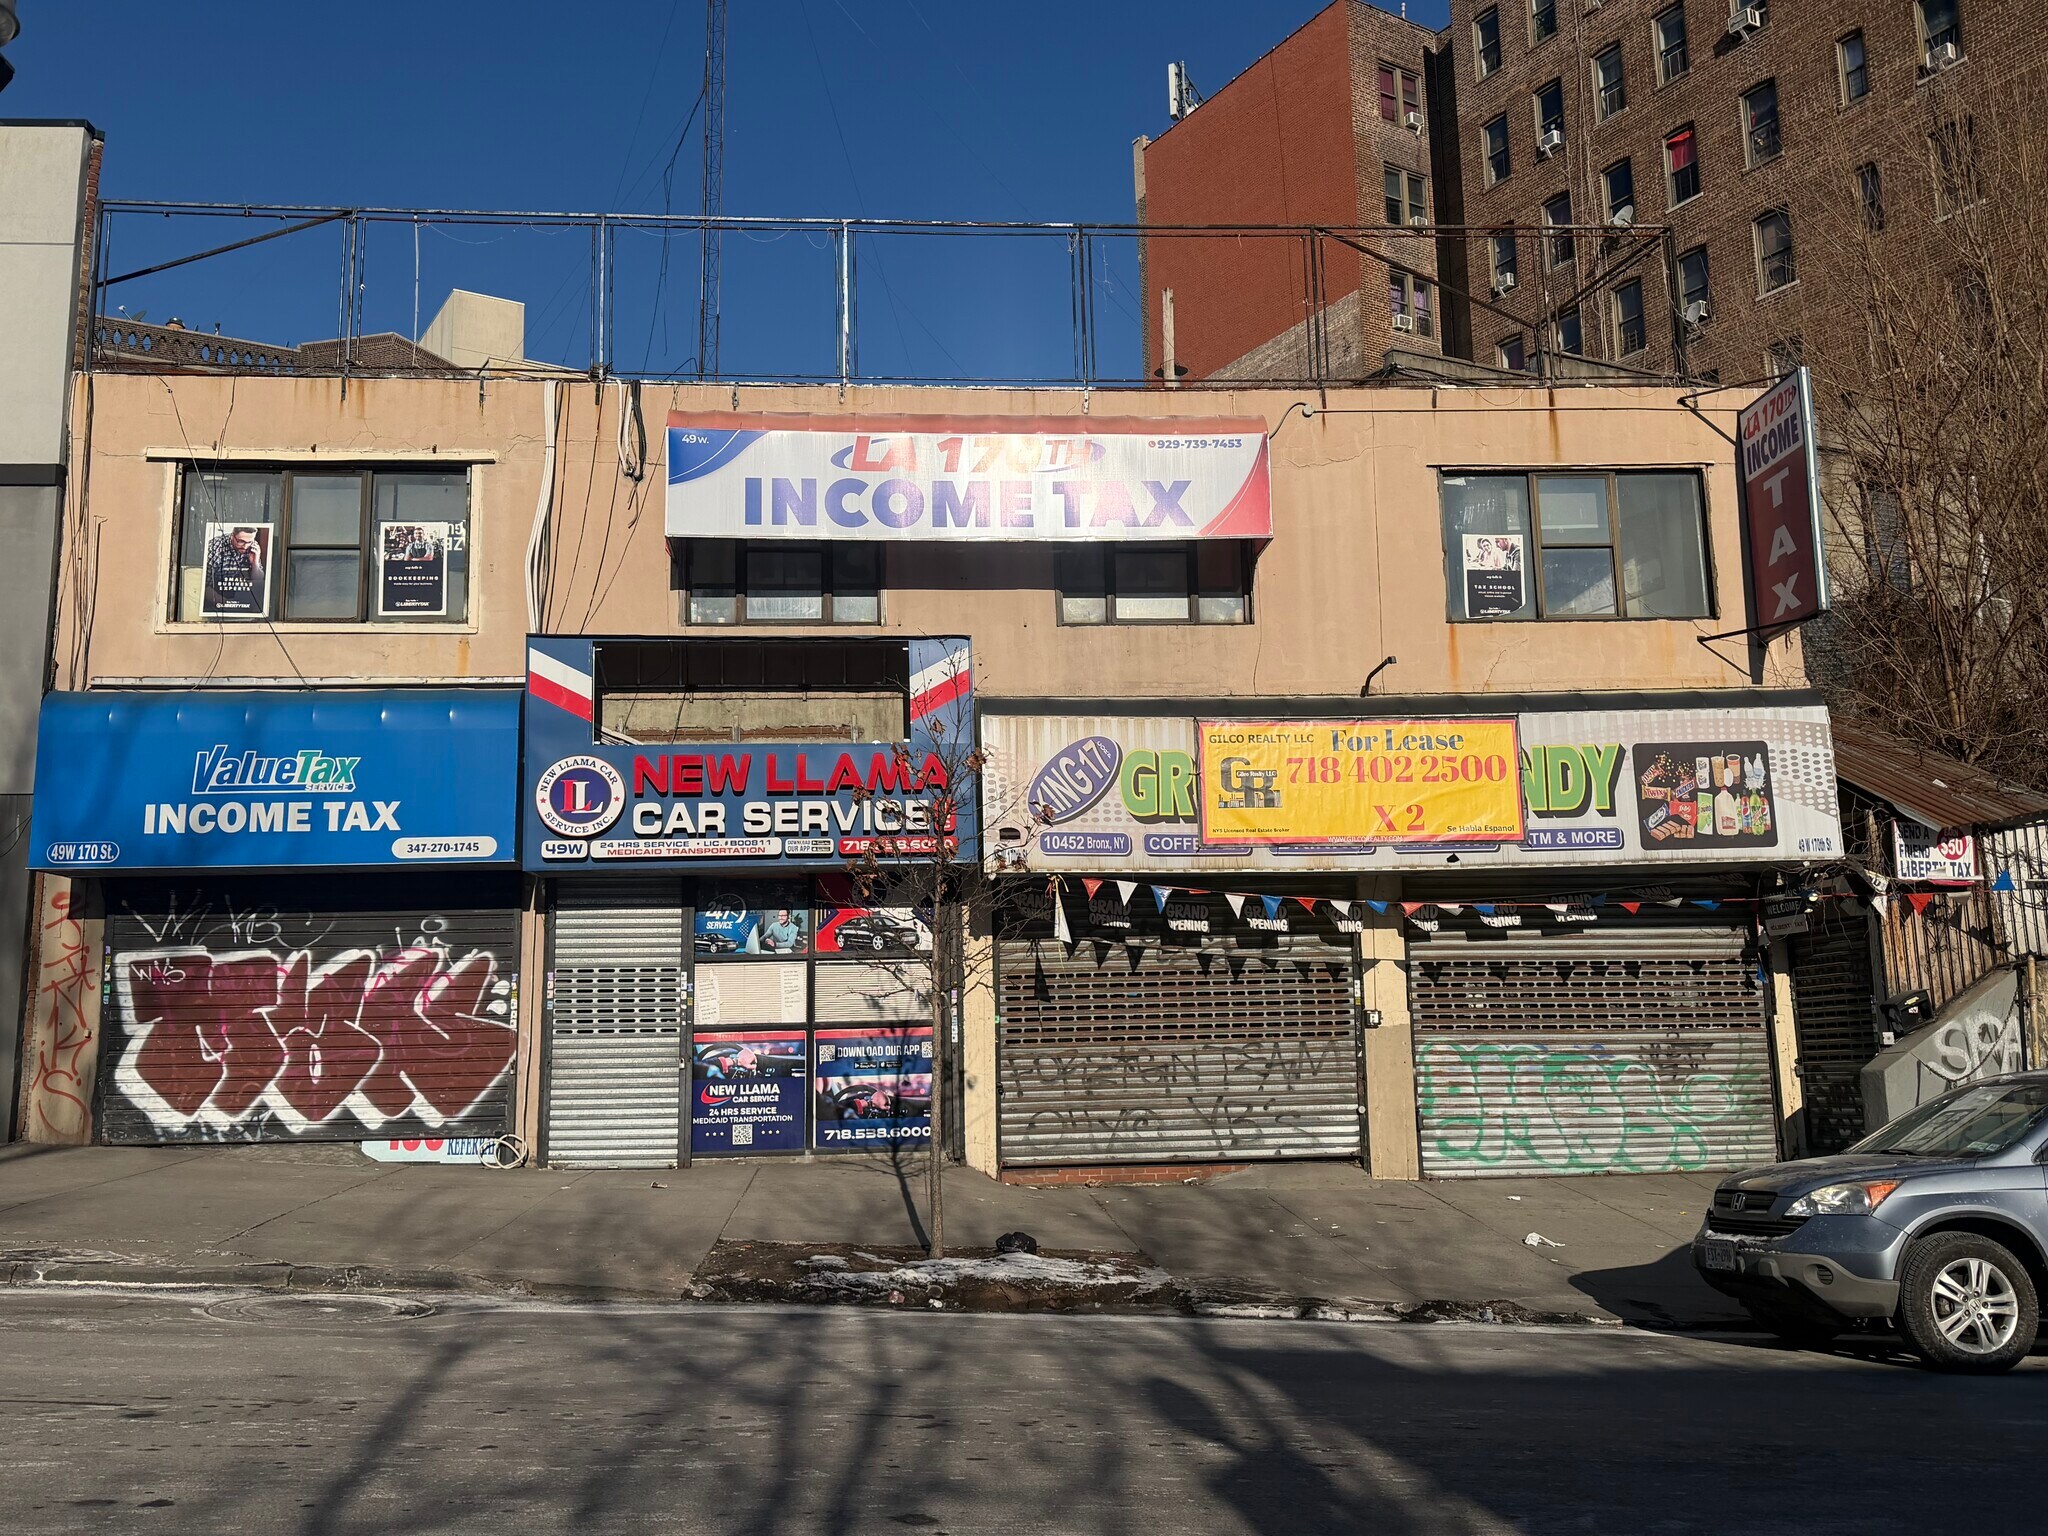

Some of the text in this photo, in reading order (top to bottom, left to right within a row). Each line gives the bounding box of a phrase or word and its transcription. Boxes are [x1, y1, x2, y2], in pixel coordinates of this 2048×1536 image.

[682, 434, 696, 444] 49
[1156, 438, 1243, 450] 929-739-7453
[1747, 411, 1800, 476] INCOME
[851, 434, 918, 472] LA
[745, 477, 1197, 529] INCOME TAX
[1763, 465, 1802, 619] TAX
[1209, 733, 1315, 744] GILCO REALTY LLC
[1330, 729, 1464, 752] For Lease
[540, 758, 618, 792] NEW LLAMA CAR
[633, 752, 949, 793] NEW LLAMA
[1286, 754, 1508, 784] 718 402 2500
[304, 783, 351, 791] SERVICE
[143, 801, 401, 834] INCOME TAX
[544, 811, 613, 834] SERVICE INC.
[633, 801, 727, 835] CAR
[743, 799, 930, 833] SERVICE
[1373, 804, 1426, 832] X 2
[1446, 824, 1516, 834] Se Habla Espanol
[1898, 825, 1922, 840] SEND
[1923, 826, 1930, 840] A
[643, 840, 690, 848] SERVICE
[1043, 835, 1125, 852] 10452 Bronx, NY
[1528, 831, 1617, 845] TM & MORE
[50, 842, 115, 861] 49W 170 St.
[406, 841, 480, 855] 347-270-1745
[545, 843, 583, 855] 49W
[607, 846, 766, 856] MEDICAID TRANSPORTATION
[1899, 843, 1931, 859] FRIEND
[1949, 862, 1972, 878] TAX
[1166, 902, 1210, 920] GRAND
[1766, 899, 1801, 916] WELCOME
[705, 920, 735, 930] SERVICE
[837, 1044, 920, 1058] DOWNLOAD OUR APP
[709, 1082, 781, 1097] NEW LLAMA
[732, 1095, 780, 1104] CAR SERVICE
[709, 1106, 778, 1116] 24 HRS SERVICE
[692, 1114, 793, 1125] MEDICAID TRANSPORTATION
[824, 1126, 931, 1141] 718.538.6000
